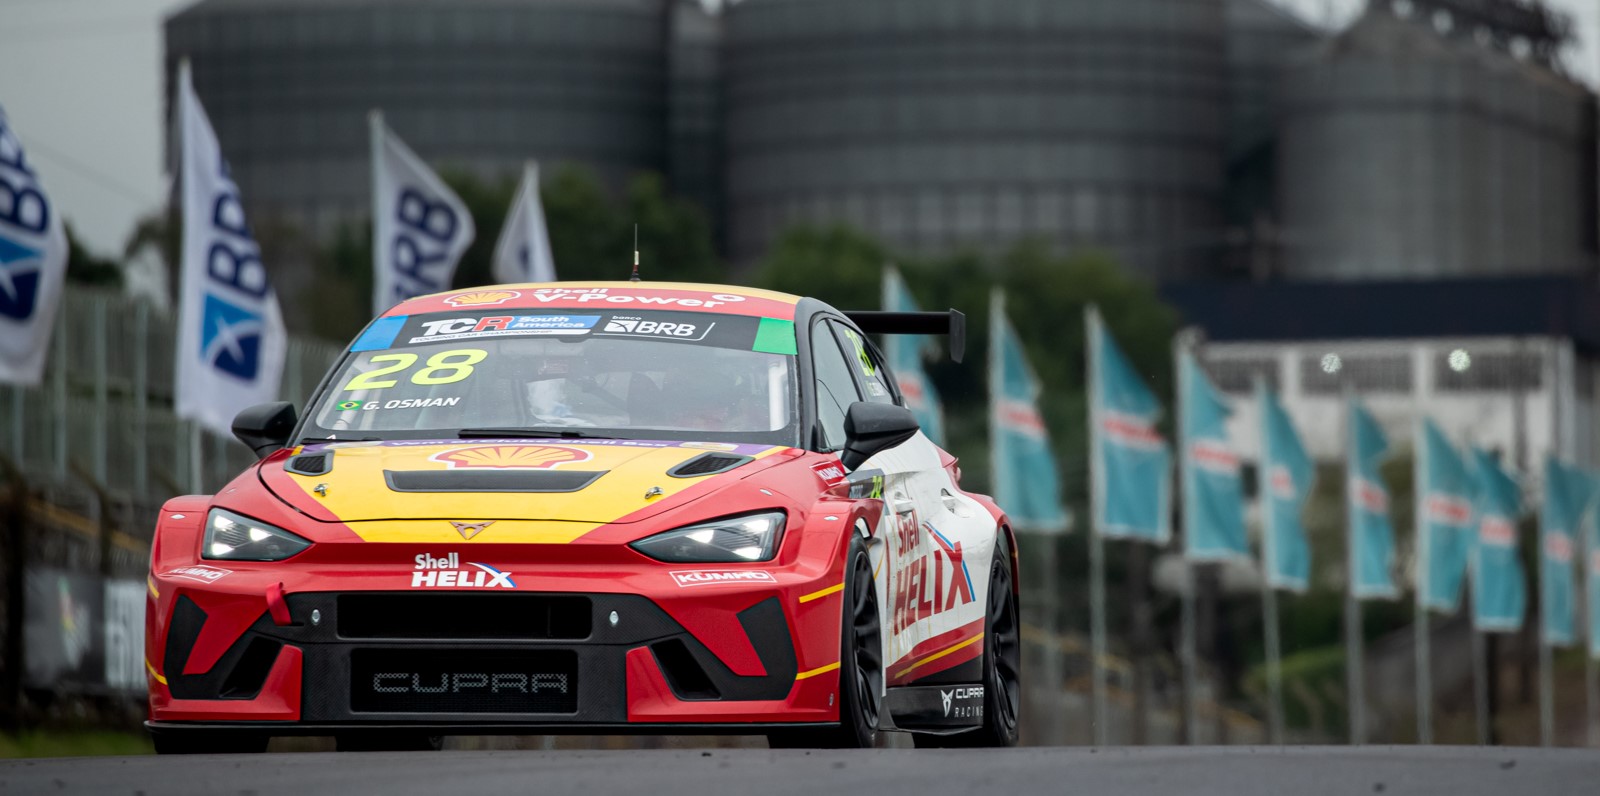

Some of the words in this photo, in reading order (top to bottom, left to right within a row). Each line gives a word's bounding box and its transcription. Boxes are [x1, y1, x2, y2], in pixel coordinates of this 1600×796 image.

[532, 293, 726, 308] V-Power
[421, 316, 515, 336] TCR
[636, 321, 696, 337] BRB
[343, 349, 488, 391] 28
[362, 400, 380, 410] G.
[384, 397, 461, 409] OSMAN
[896, 508, 920, 558] Shell
[414, 552, 459, 570] Shell
[168, 567, 224, 579] KUMHO
[411, 568, 515, 588] HELIX
[677, 571, 770, 583] KUMHO
[893, 541, 972, 636] HELIX
[373, 673, 568, 693] CUPRA
[955, 687, 984, 699] CUPRA
